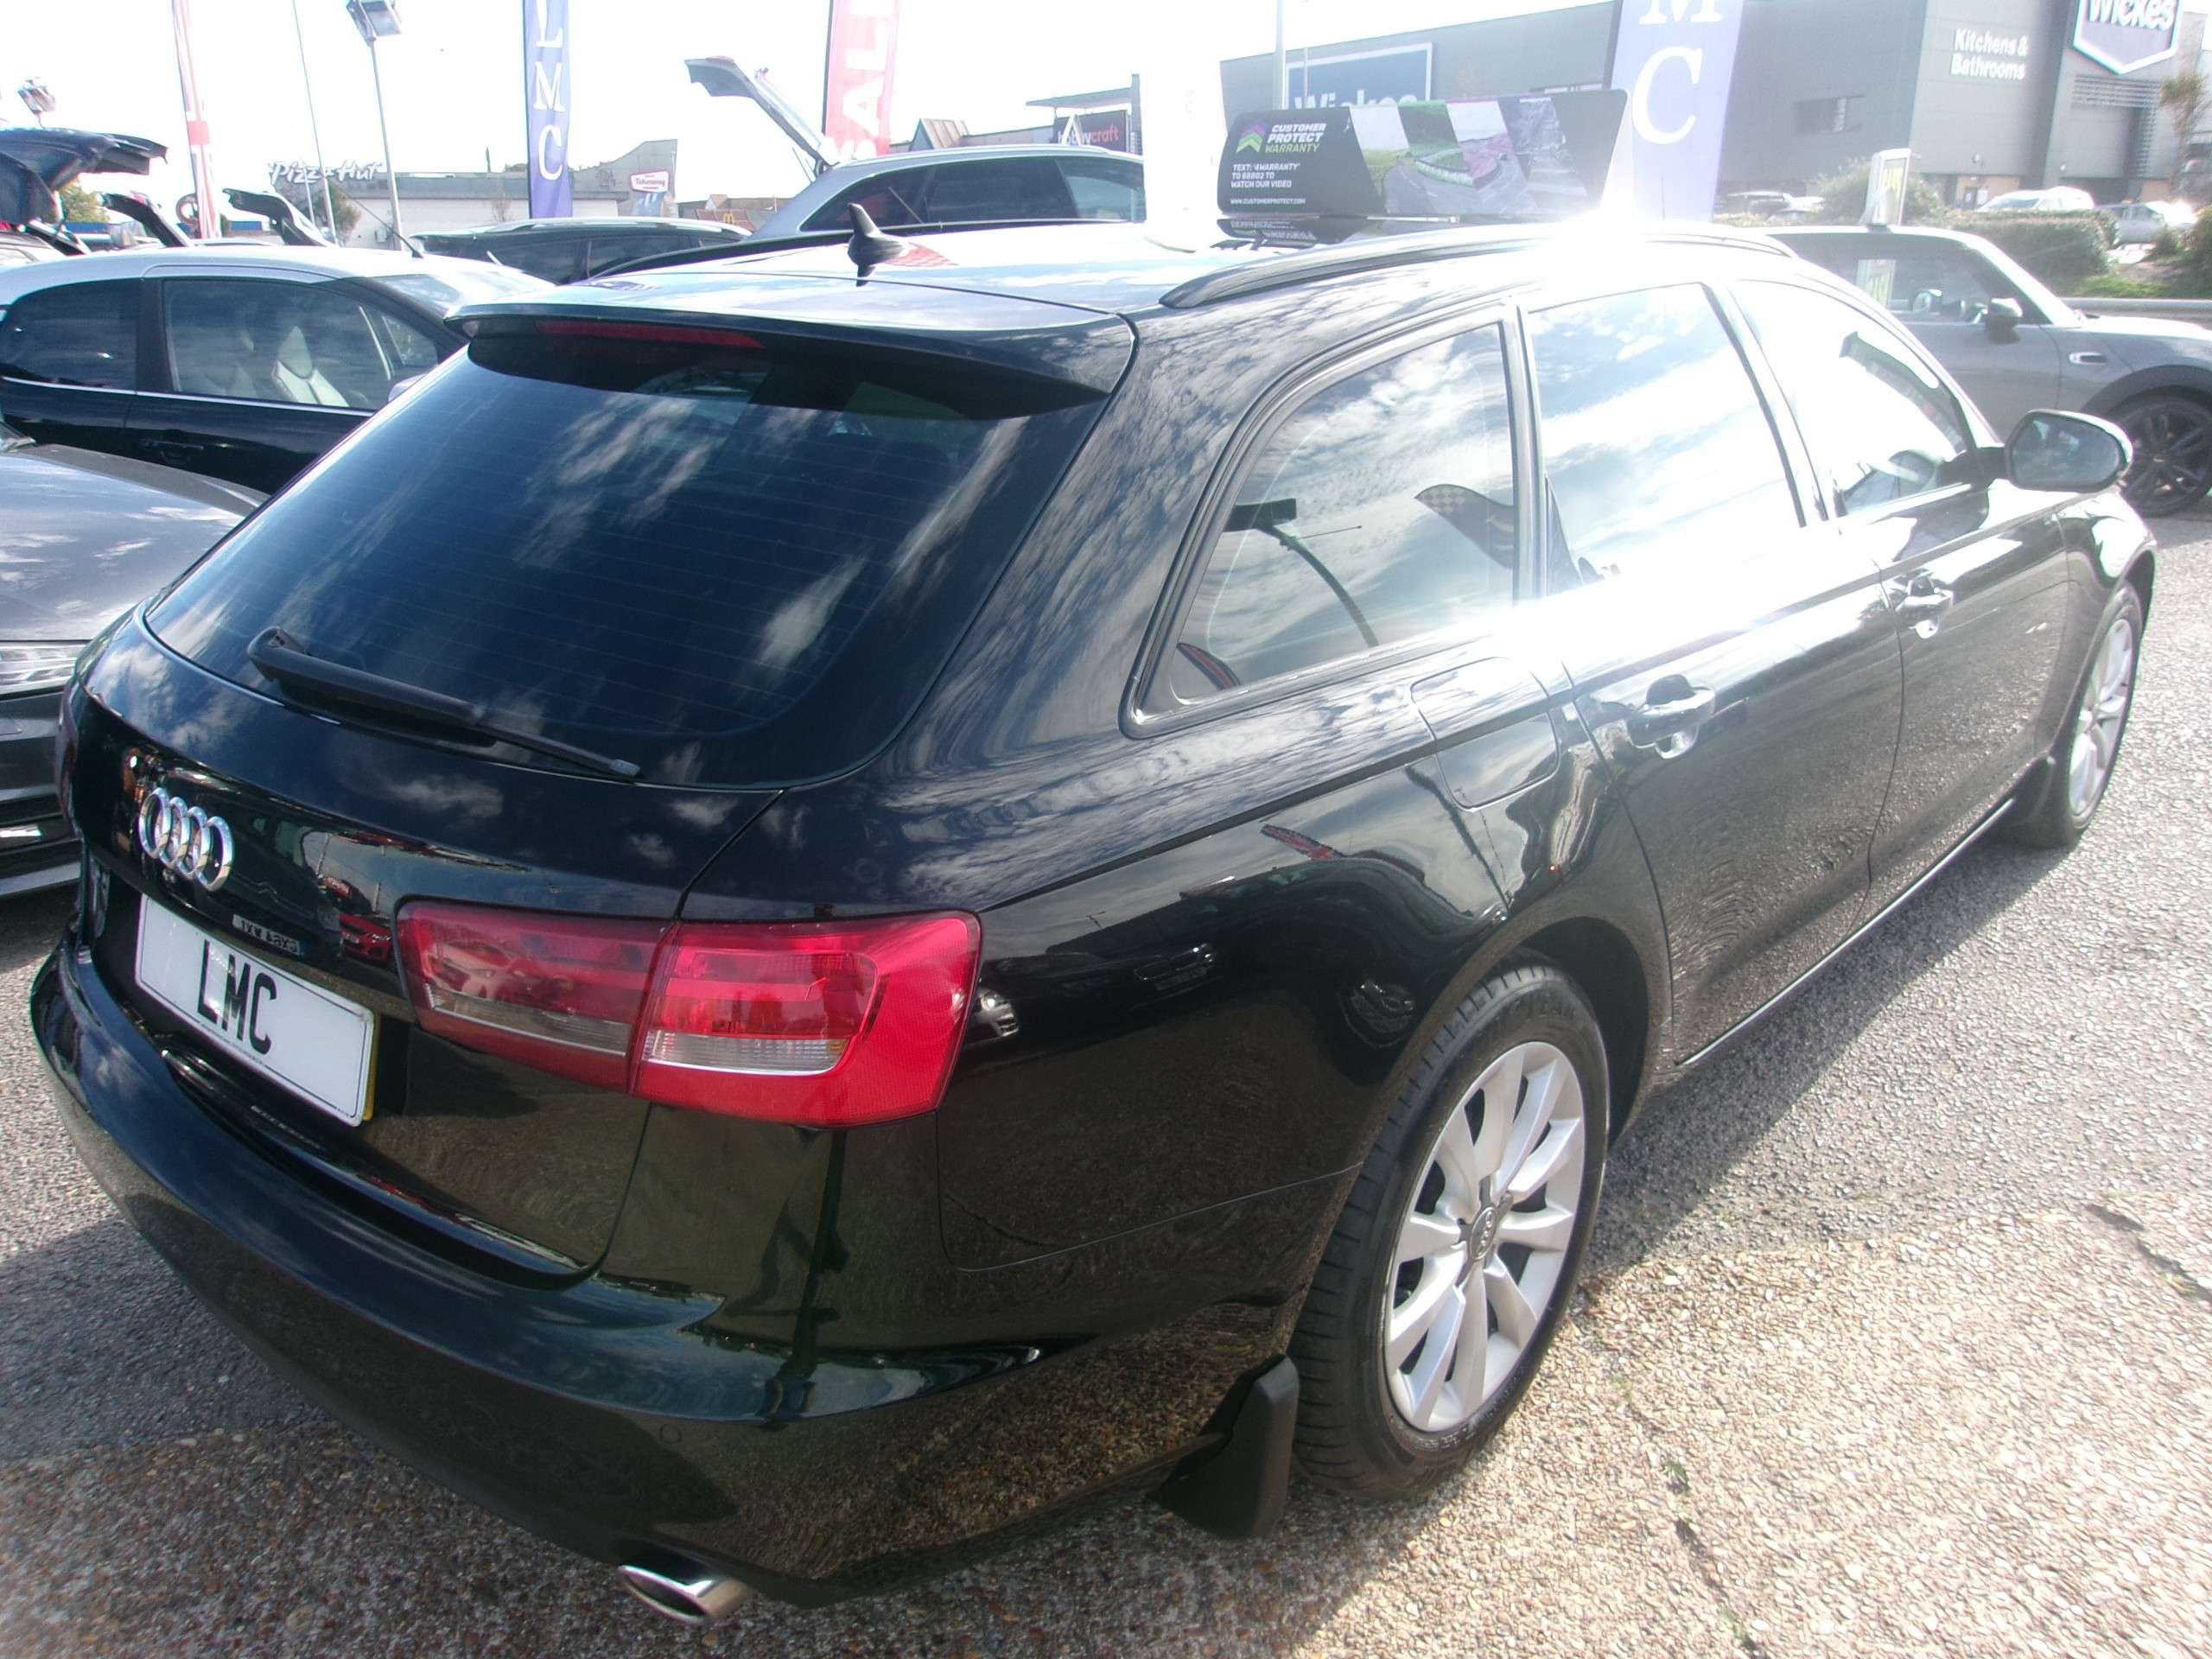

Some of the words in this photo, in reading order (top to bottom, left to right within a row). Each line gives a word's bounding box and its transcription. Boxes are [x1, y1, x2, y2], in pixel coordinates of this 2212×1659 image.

[1954, 28, 2018, 55] Kitchens
[2018, 35, 2029, 57] &
[1950, 53, 2026, 80] Bathrooms
[1271, 123, 1327, 134] CUSTOMER
[1267, 132, 1325, 144] PROTECT
[1264, 143, 1320, 154] WARRANTY
[336, 159, 385, 182] Hut
[1255, 180, 1270, 188] OUR
[1271, 180, 1293, 188] VIDEO
[197, 939, 276, 1055] LMC
